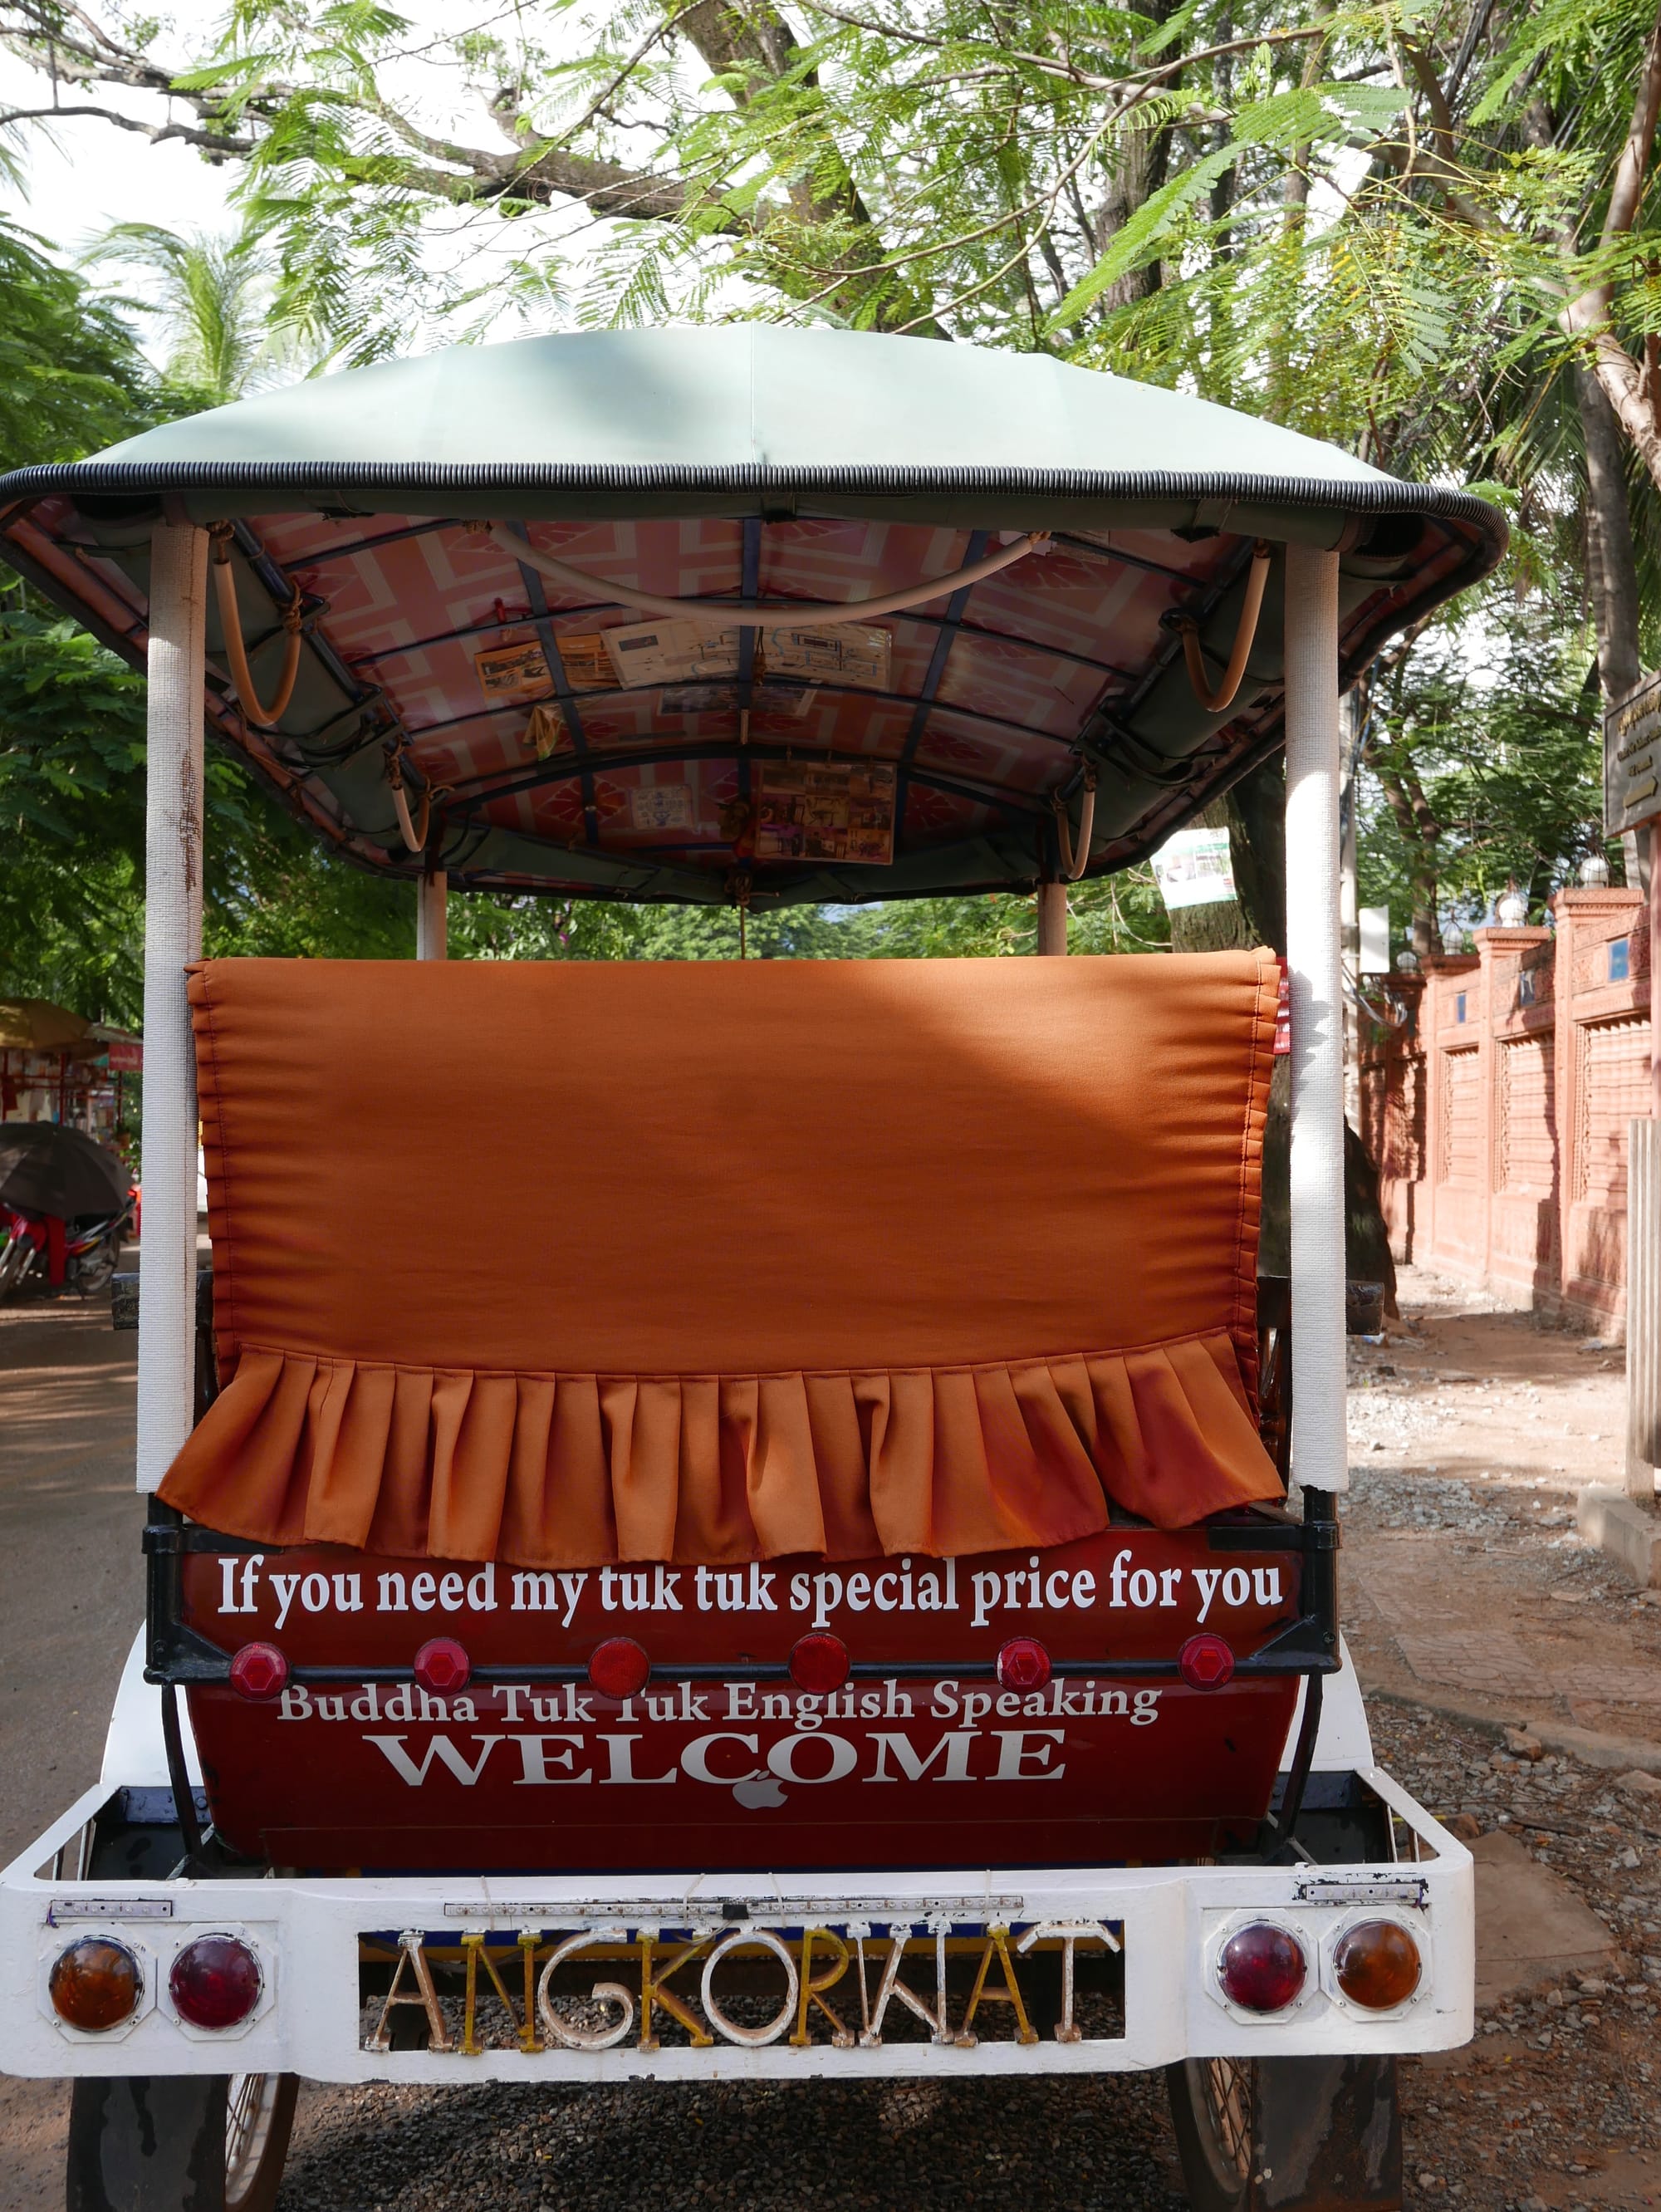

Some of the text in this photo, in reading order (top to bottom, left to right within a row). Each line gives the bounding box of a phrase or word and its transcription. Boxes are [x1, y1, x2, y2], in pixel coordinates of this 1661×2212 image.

[217, 1549, 1284, 1630] If you need my tuk tuk special price for you
[277, 1682, 479, 1723] Buddha
[492, 1683, 596, 1723] Tuk
[722, 1678, 916, 1732] English
[930, 1677, 1164, 1728] Speaking
[361, 1729, 1066, 1787] WELCOME
